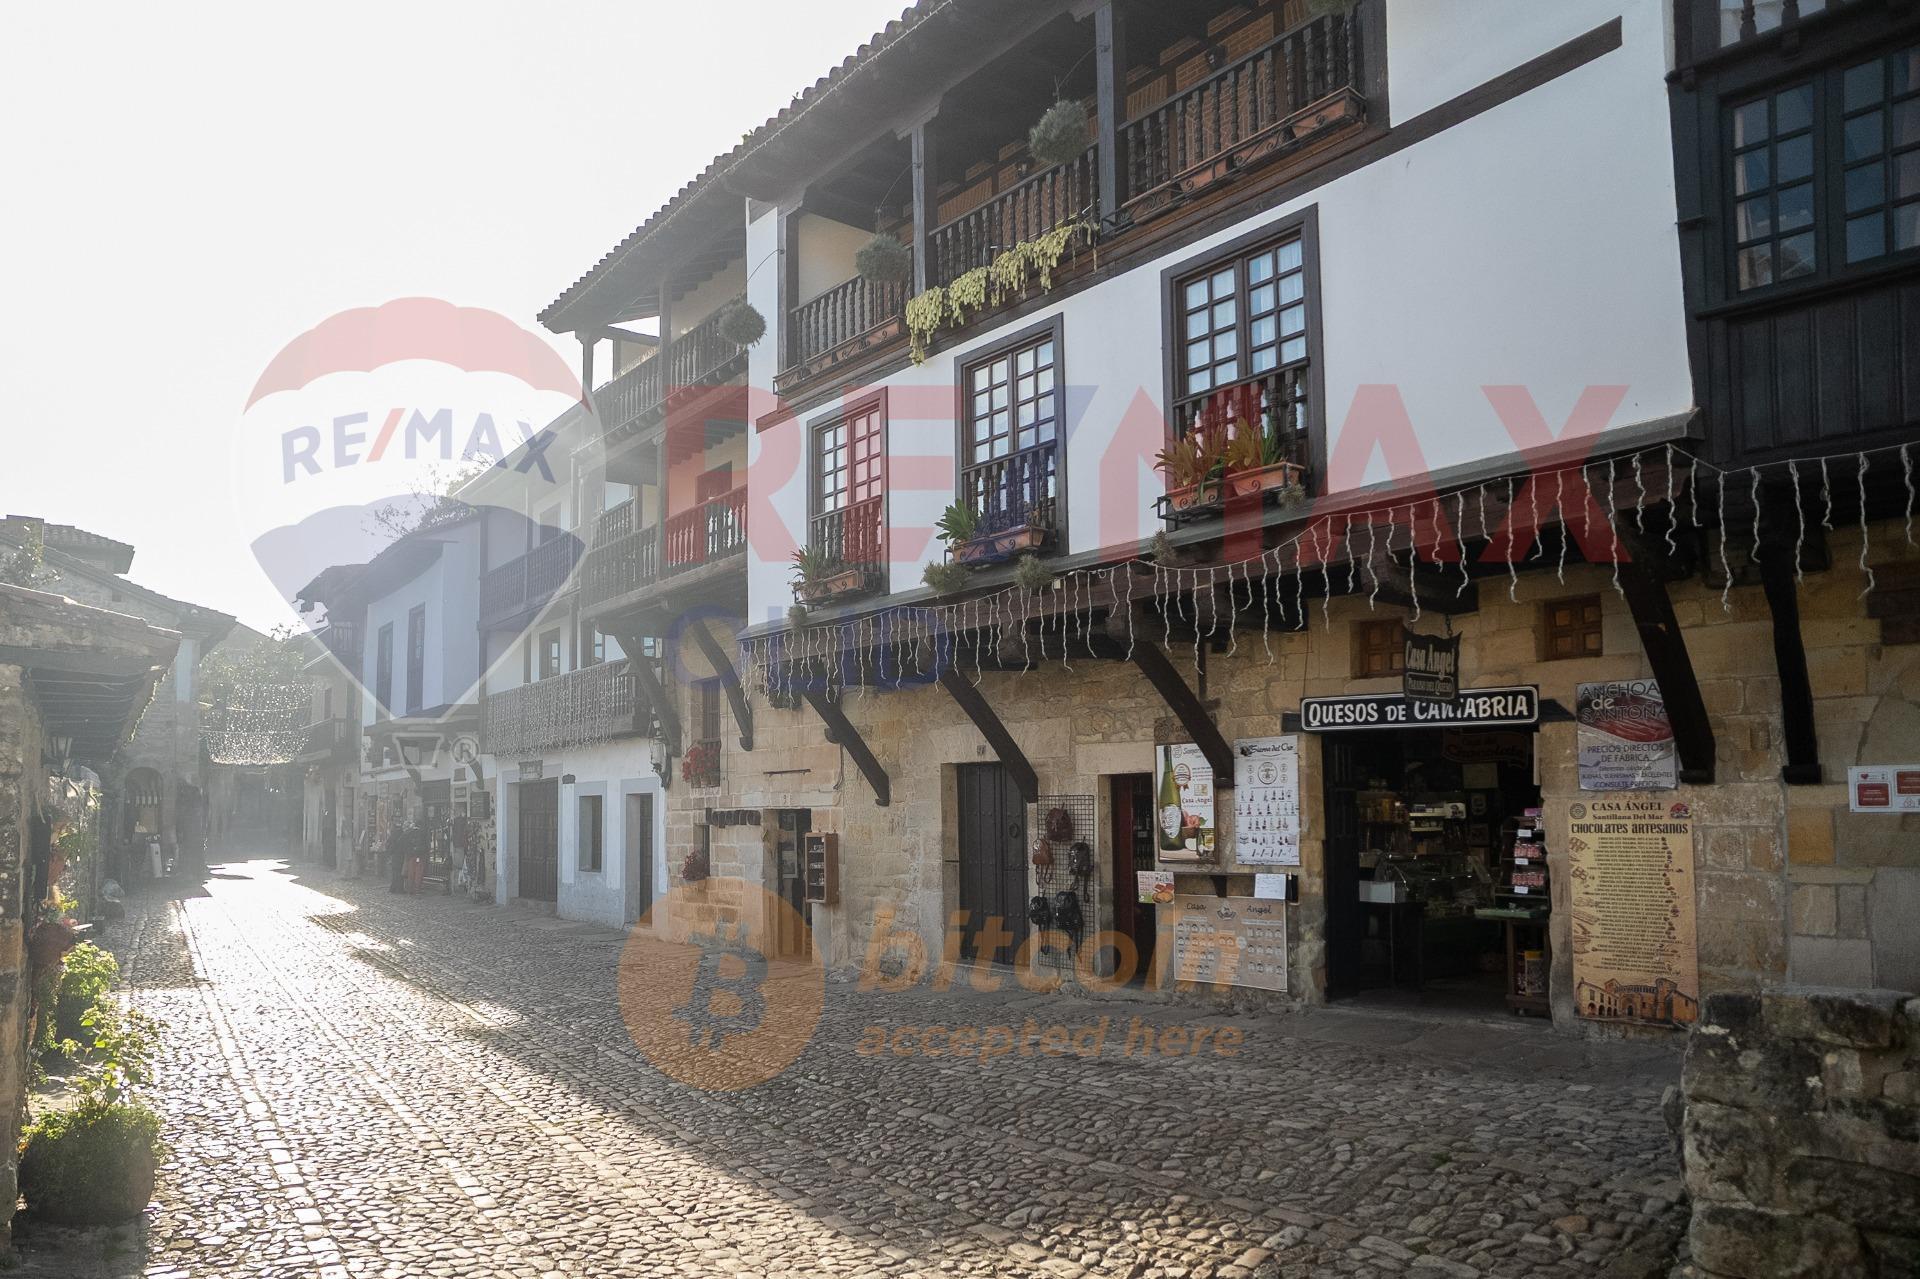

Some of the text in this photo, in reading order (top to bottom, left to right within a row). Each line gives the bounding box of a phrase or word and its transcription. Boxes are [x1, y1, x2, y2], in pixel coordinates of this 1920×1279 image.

[1405, 640, 1426, 671] Casa
[1581, 681, 1660, 698] ANCHOA
[1591, 695, 1615, 710] de
[1308, 702, 1378, 727] QUESOS
[1384, 704, 1406, 721] DE
[1587, 742, 1664, 753] PRECIOS DIRECTOS
[1601, 754, 1611, 762] DE
[1592, 800, 1664, 811] CASA ÁNGEL
